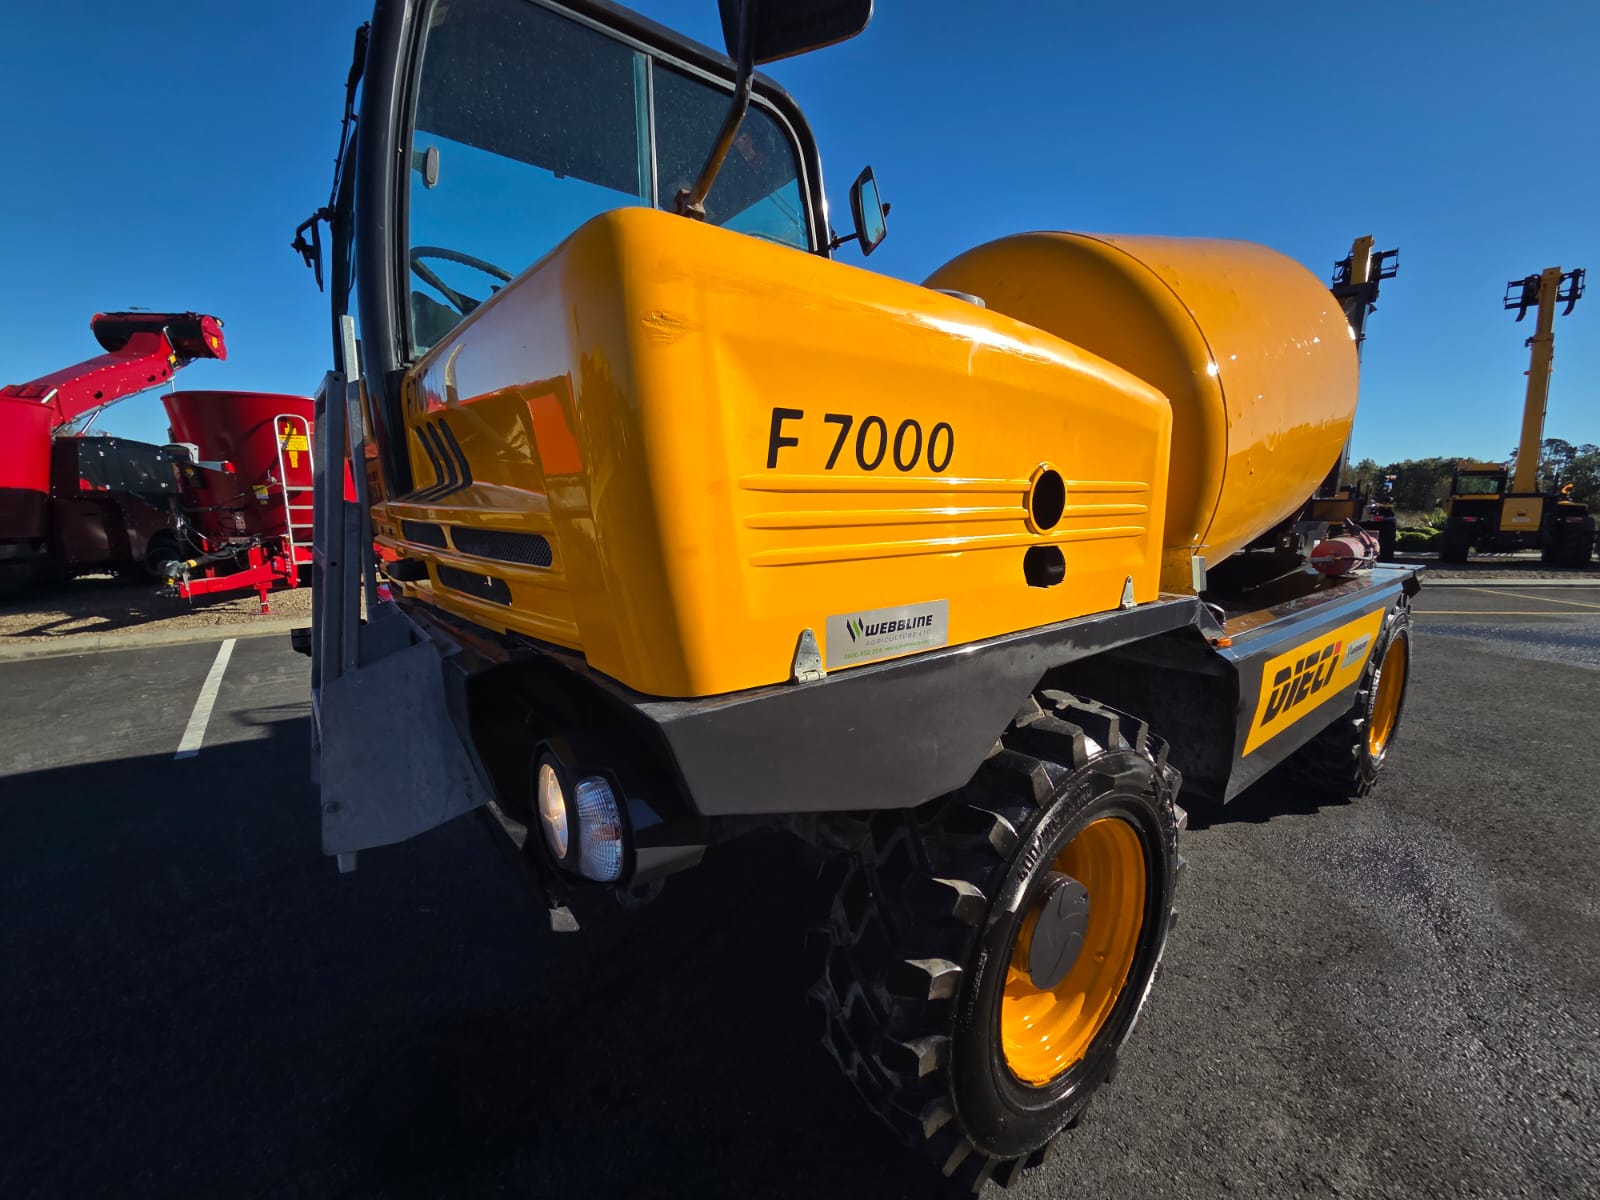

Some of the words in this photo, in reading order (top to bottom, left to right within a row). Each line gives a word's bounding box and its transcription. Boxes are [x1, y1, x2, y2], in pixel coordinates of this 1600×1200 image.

[767, 407, 804, 469] F
[824, 413, 954, 473] 7000
[865, 614, 933, 637] WEBBLINE
[1260, 641, 1342, 728] DIECI
